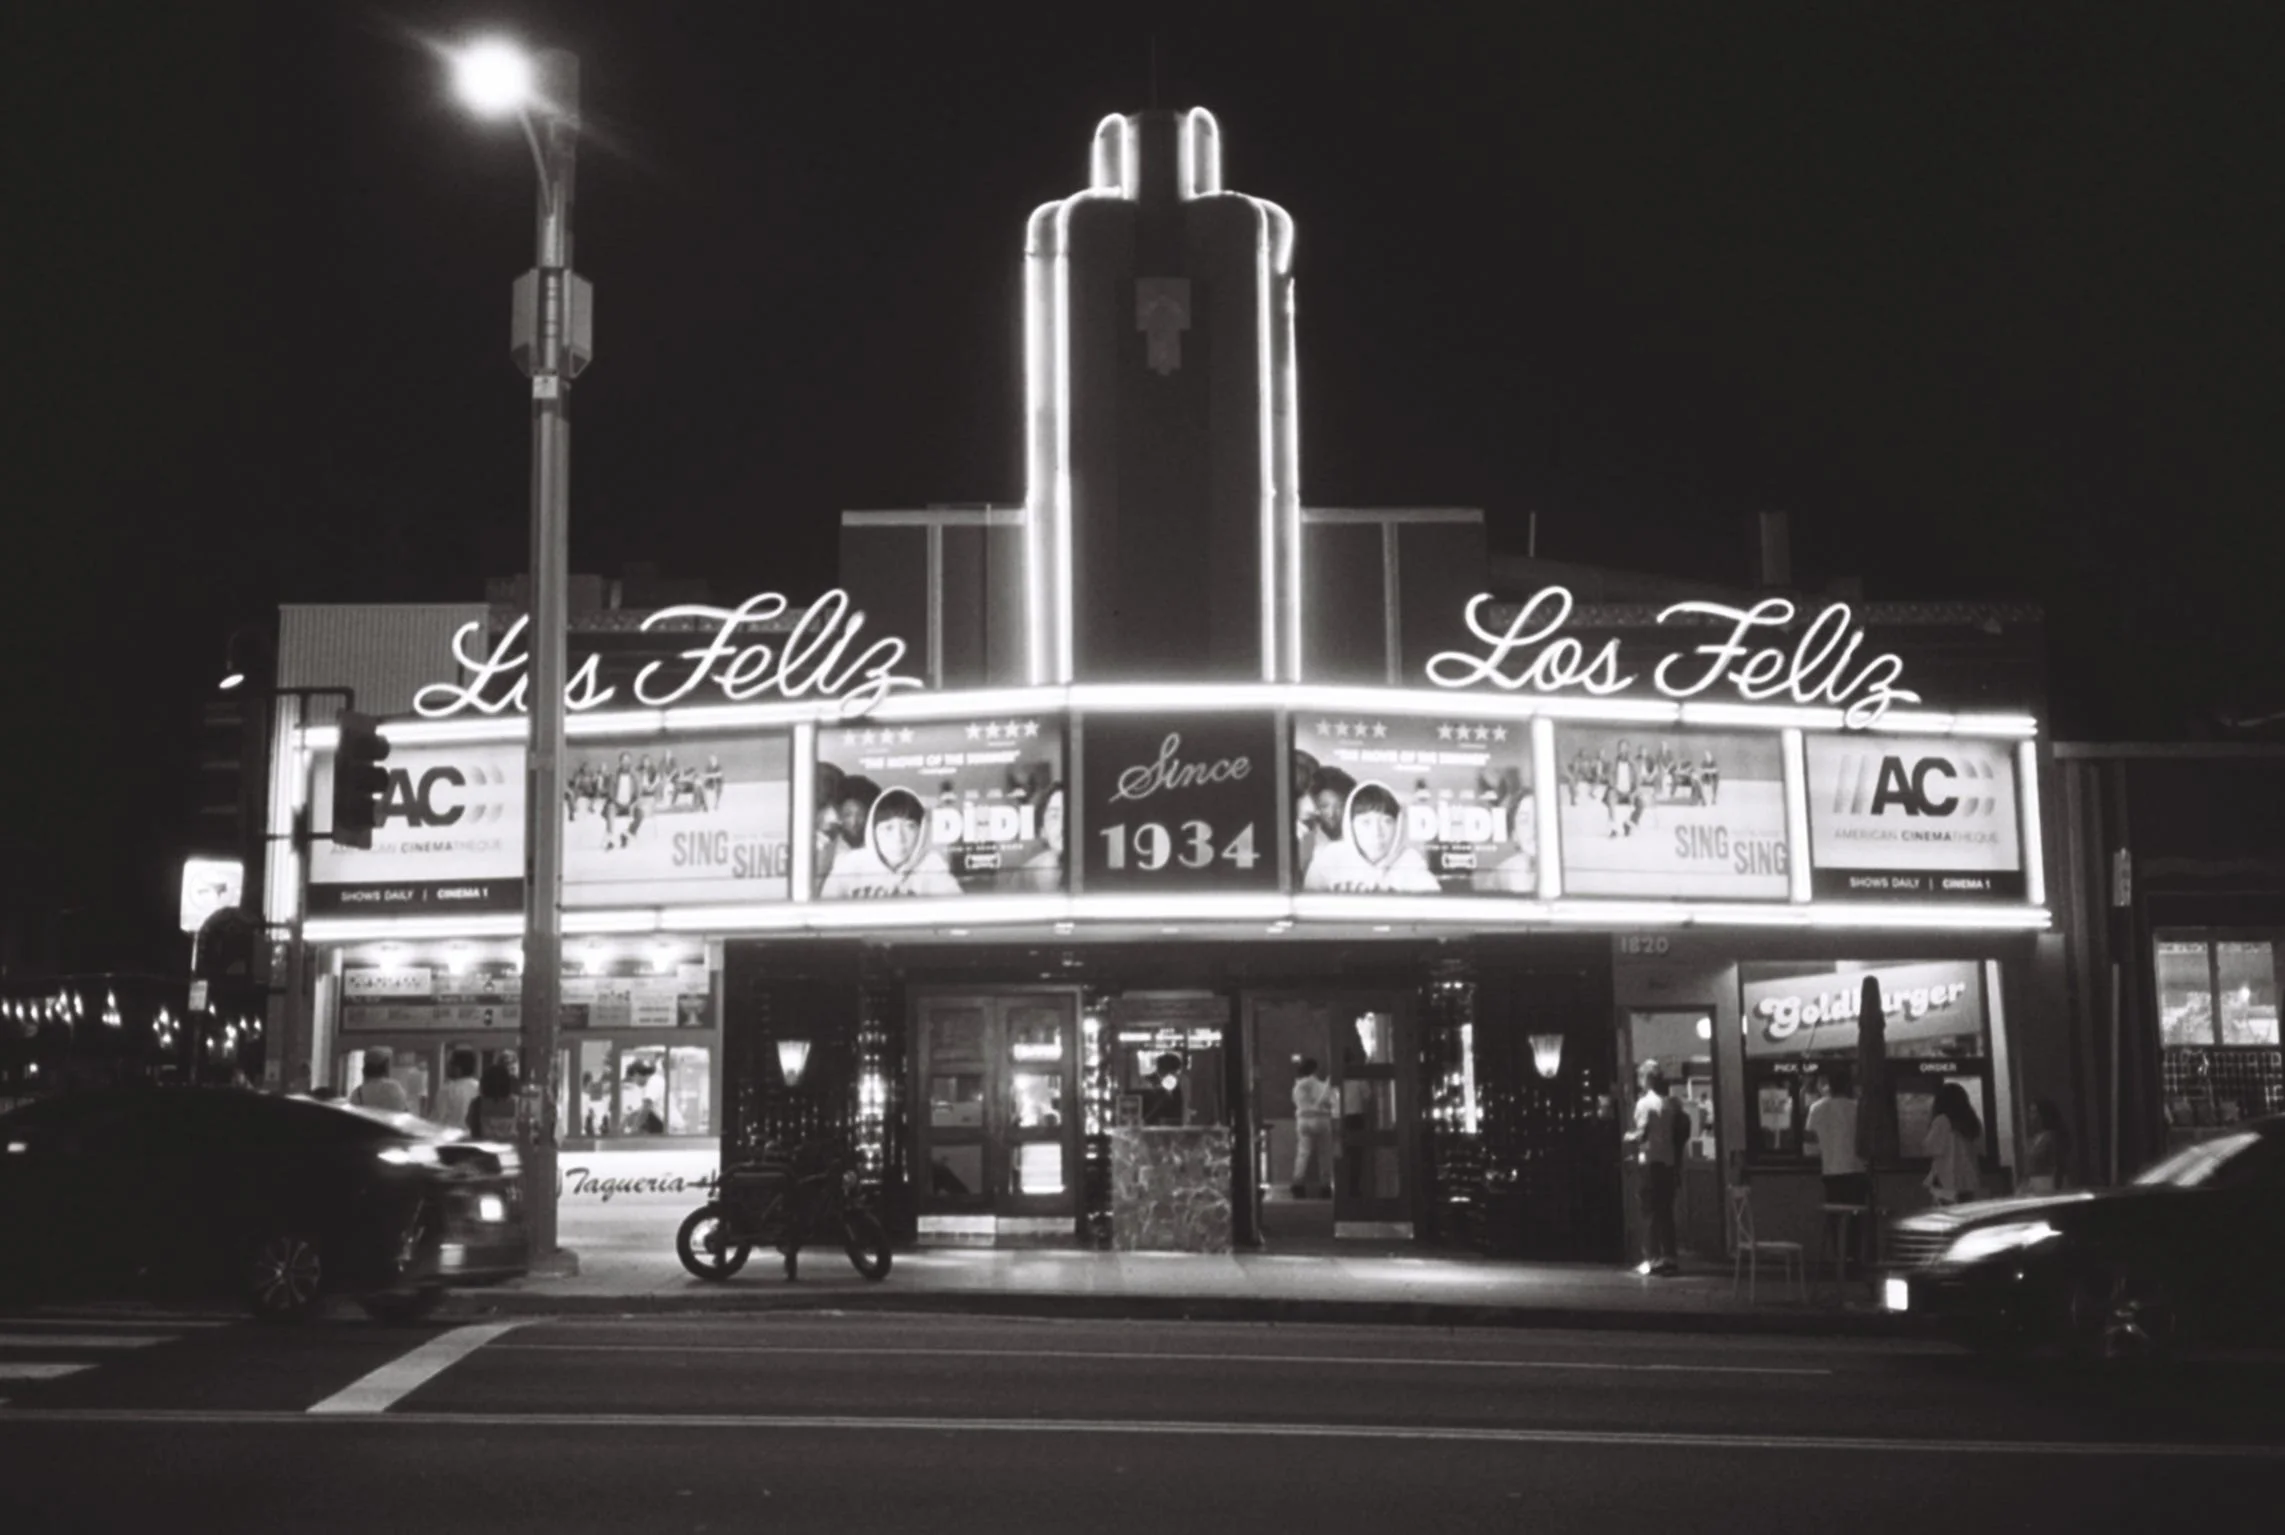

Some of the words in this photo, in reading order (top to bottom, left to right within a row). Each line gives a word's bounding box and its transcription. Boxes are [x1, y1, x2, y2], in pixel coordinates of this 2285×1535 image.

[633, 588, 924, 718] Feliz
[1426, 585, 1638, 694] Los
[1654, 598, 1922, 729] Feliz
[1108, 732, 1252, 803] Since
[1870, 755, 1960, 817] AC
[372, 765, 466, 828] AC
[672, 829, 729, 867] SING
[731, 842, 790, 879] SING
[1101, 820, 1260, 871] 1934
[1674, 824, 1729, 860] SING
[1733, 840, 1788, 876] SING
[1834, 828, 1898, 841] AMERICAN
[1900, 829, 1999, 844] CINEMATHEQUE
[340, 889, 381, 902] SHOWS
[384, 889, 414, 901] DAILY
[437, 887, 479, 899] CINEMA
[481, 887, 488, 898] 1
[1849, 877, 1889, 889] SHOWS
[1891, 877, 1920, 889] DAILY
[1942, 877, 1983, 889] CINEMA
[1985, 878, 1991, 889] 1
[1621, 935, 1670, 954] 1820
[1774, 1063, 1798, 1073] PICK
[1803, 1063, 1818, 1073] UP
[1919, 1062, 1957, 1073] ORDER
